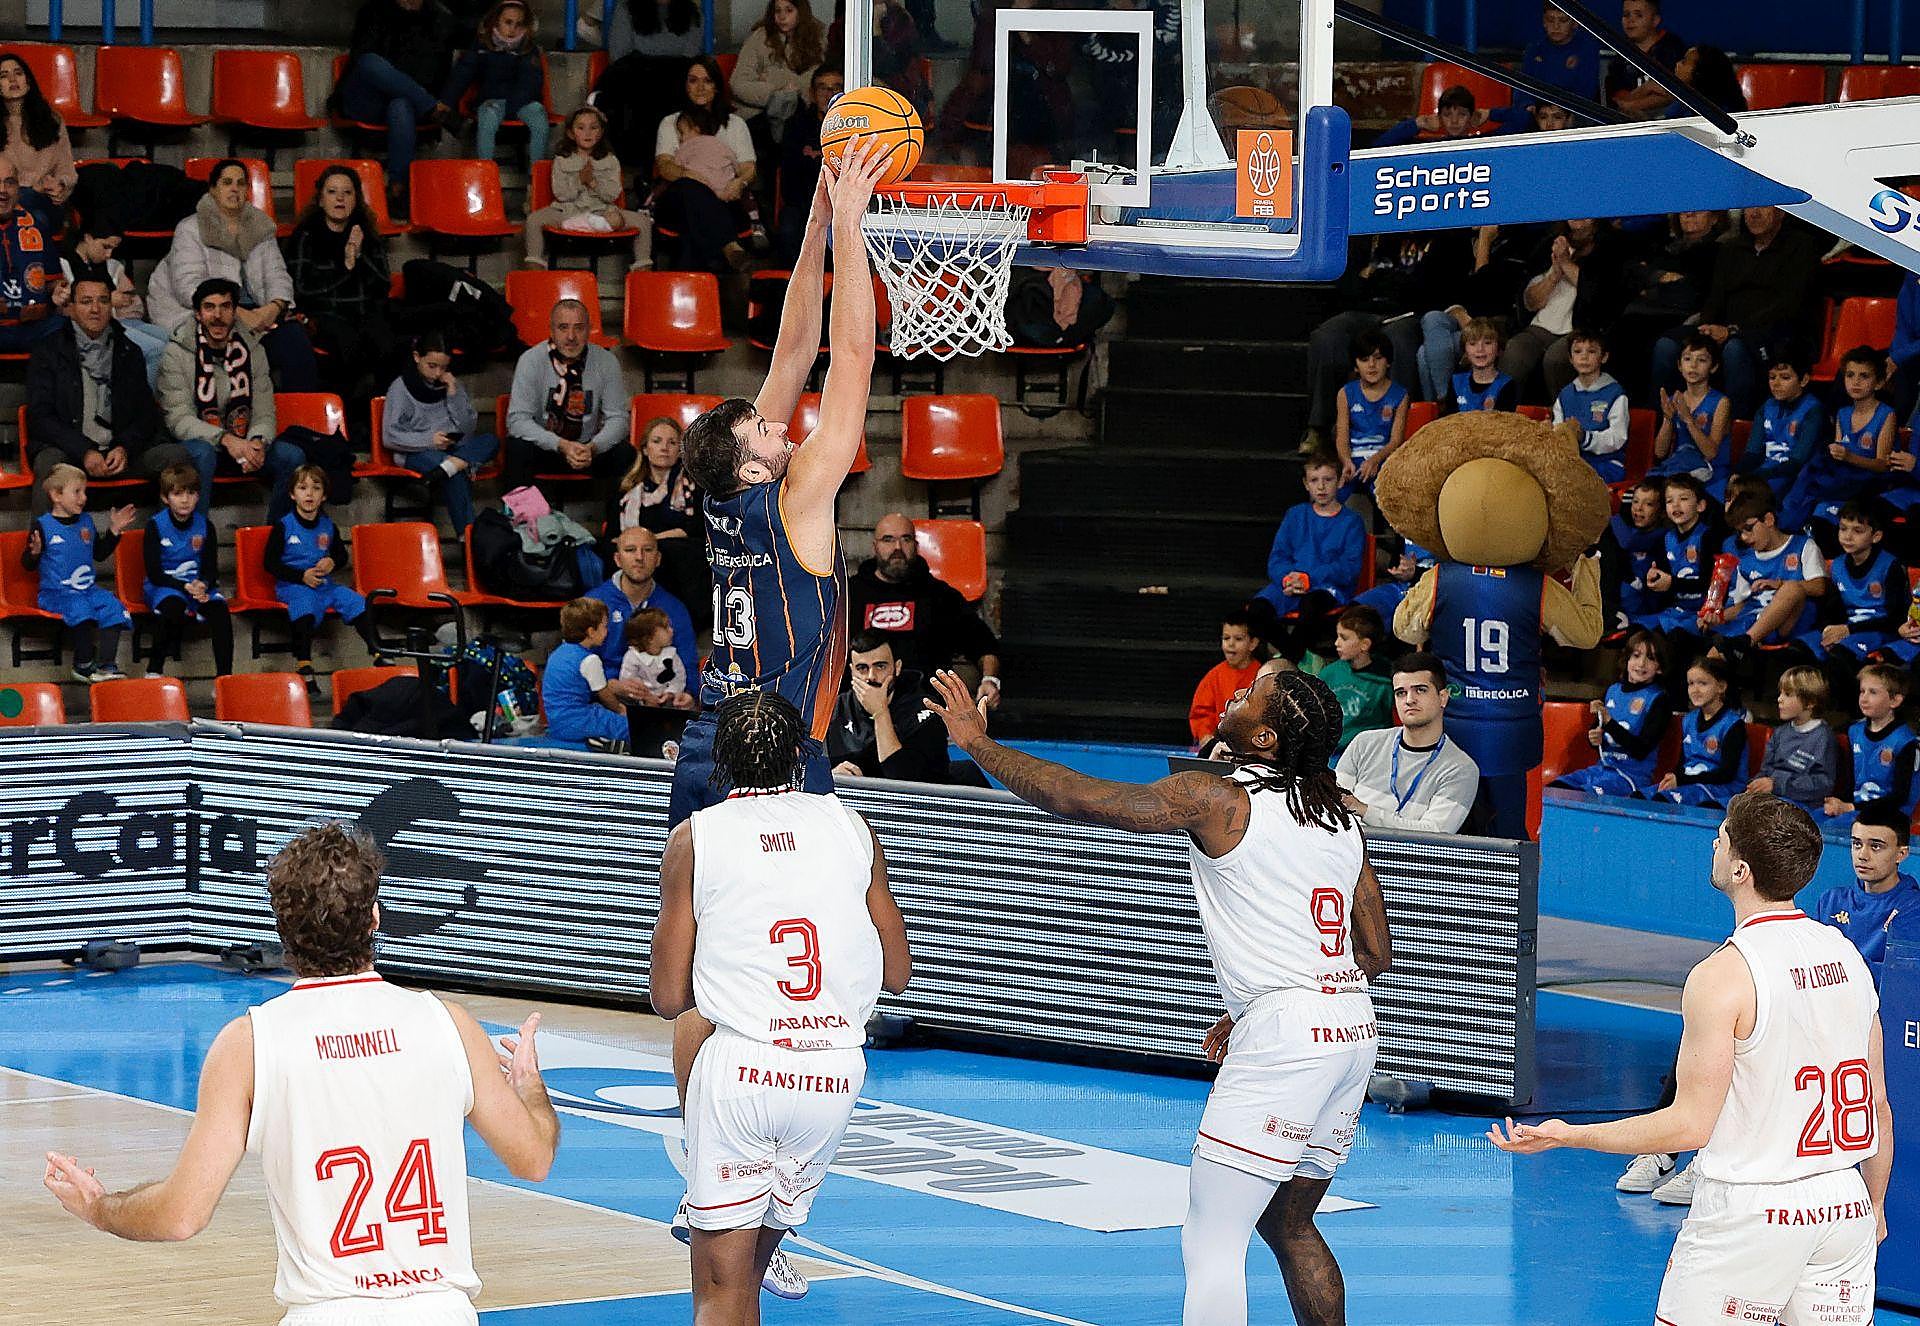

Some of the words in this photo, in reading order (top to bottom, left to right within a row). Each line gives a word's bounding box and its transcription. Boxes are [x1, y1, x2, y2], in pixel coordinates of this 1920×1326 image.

[1375, 161, 1491, 190] Schelde
[1253, 205, 1274, 216] FEB
[1374, 187, 1490, 220] Sports
[712, 583, 756, 650] 13
[1462, 617, 1509, 673] 19
[0, 783, 257, 892] rCaja
[760, 831, 796, 852] SMITH
[1310, 887, 1347, 957] 9
[768, 917, 822, 1001] 3
[1808, 961, 1849, 989] LISBOA
[315, 1028, 401, 1060] MCDONNELL
[737, 1066, 850, 1094] TRANSITERIA
[1794, 1058, 1875, 1157] 28
[315, 1138, 448, 1259] 24
[1746, 1303, 1777, 1315] Concello
